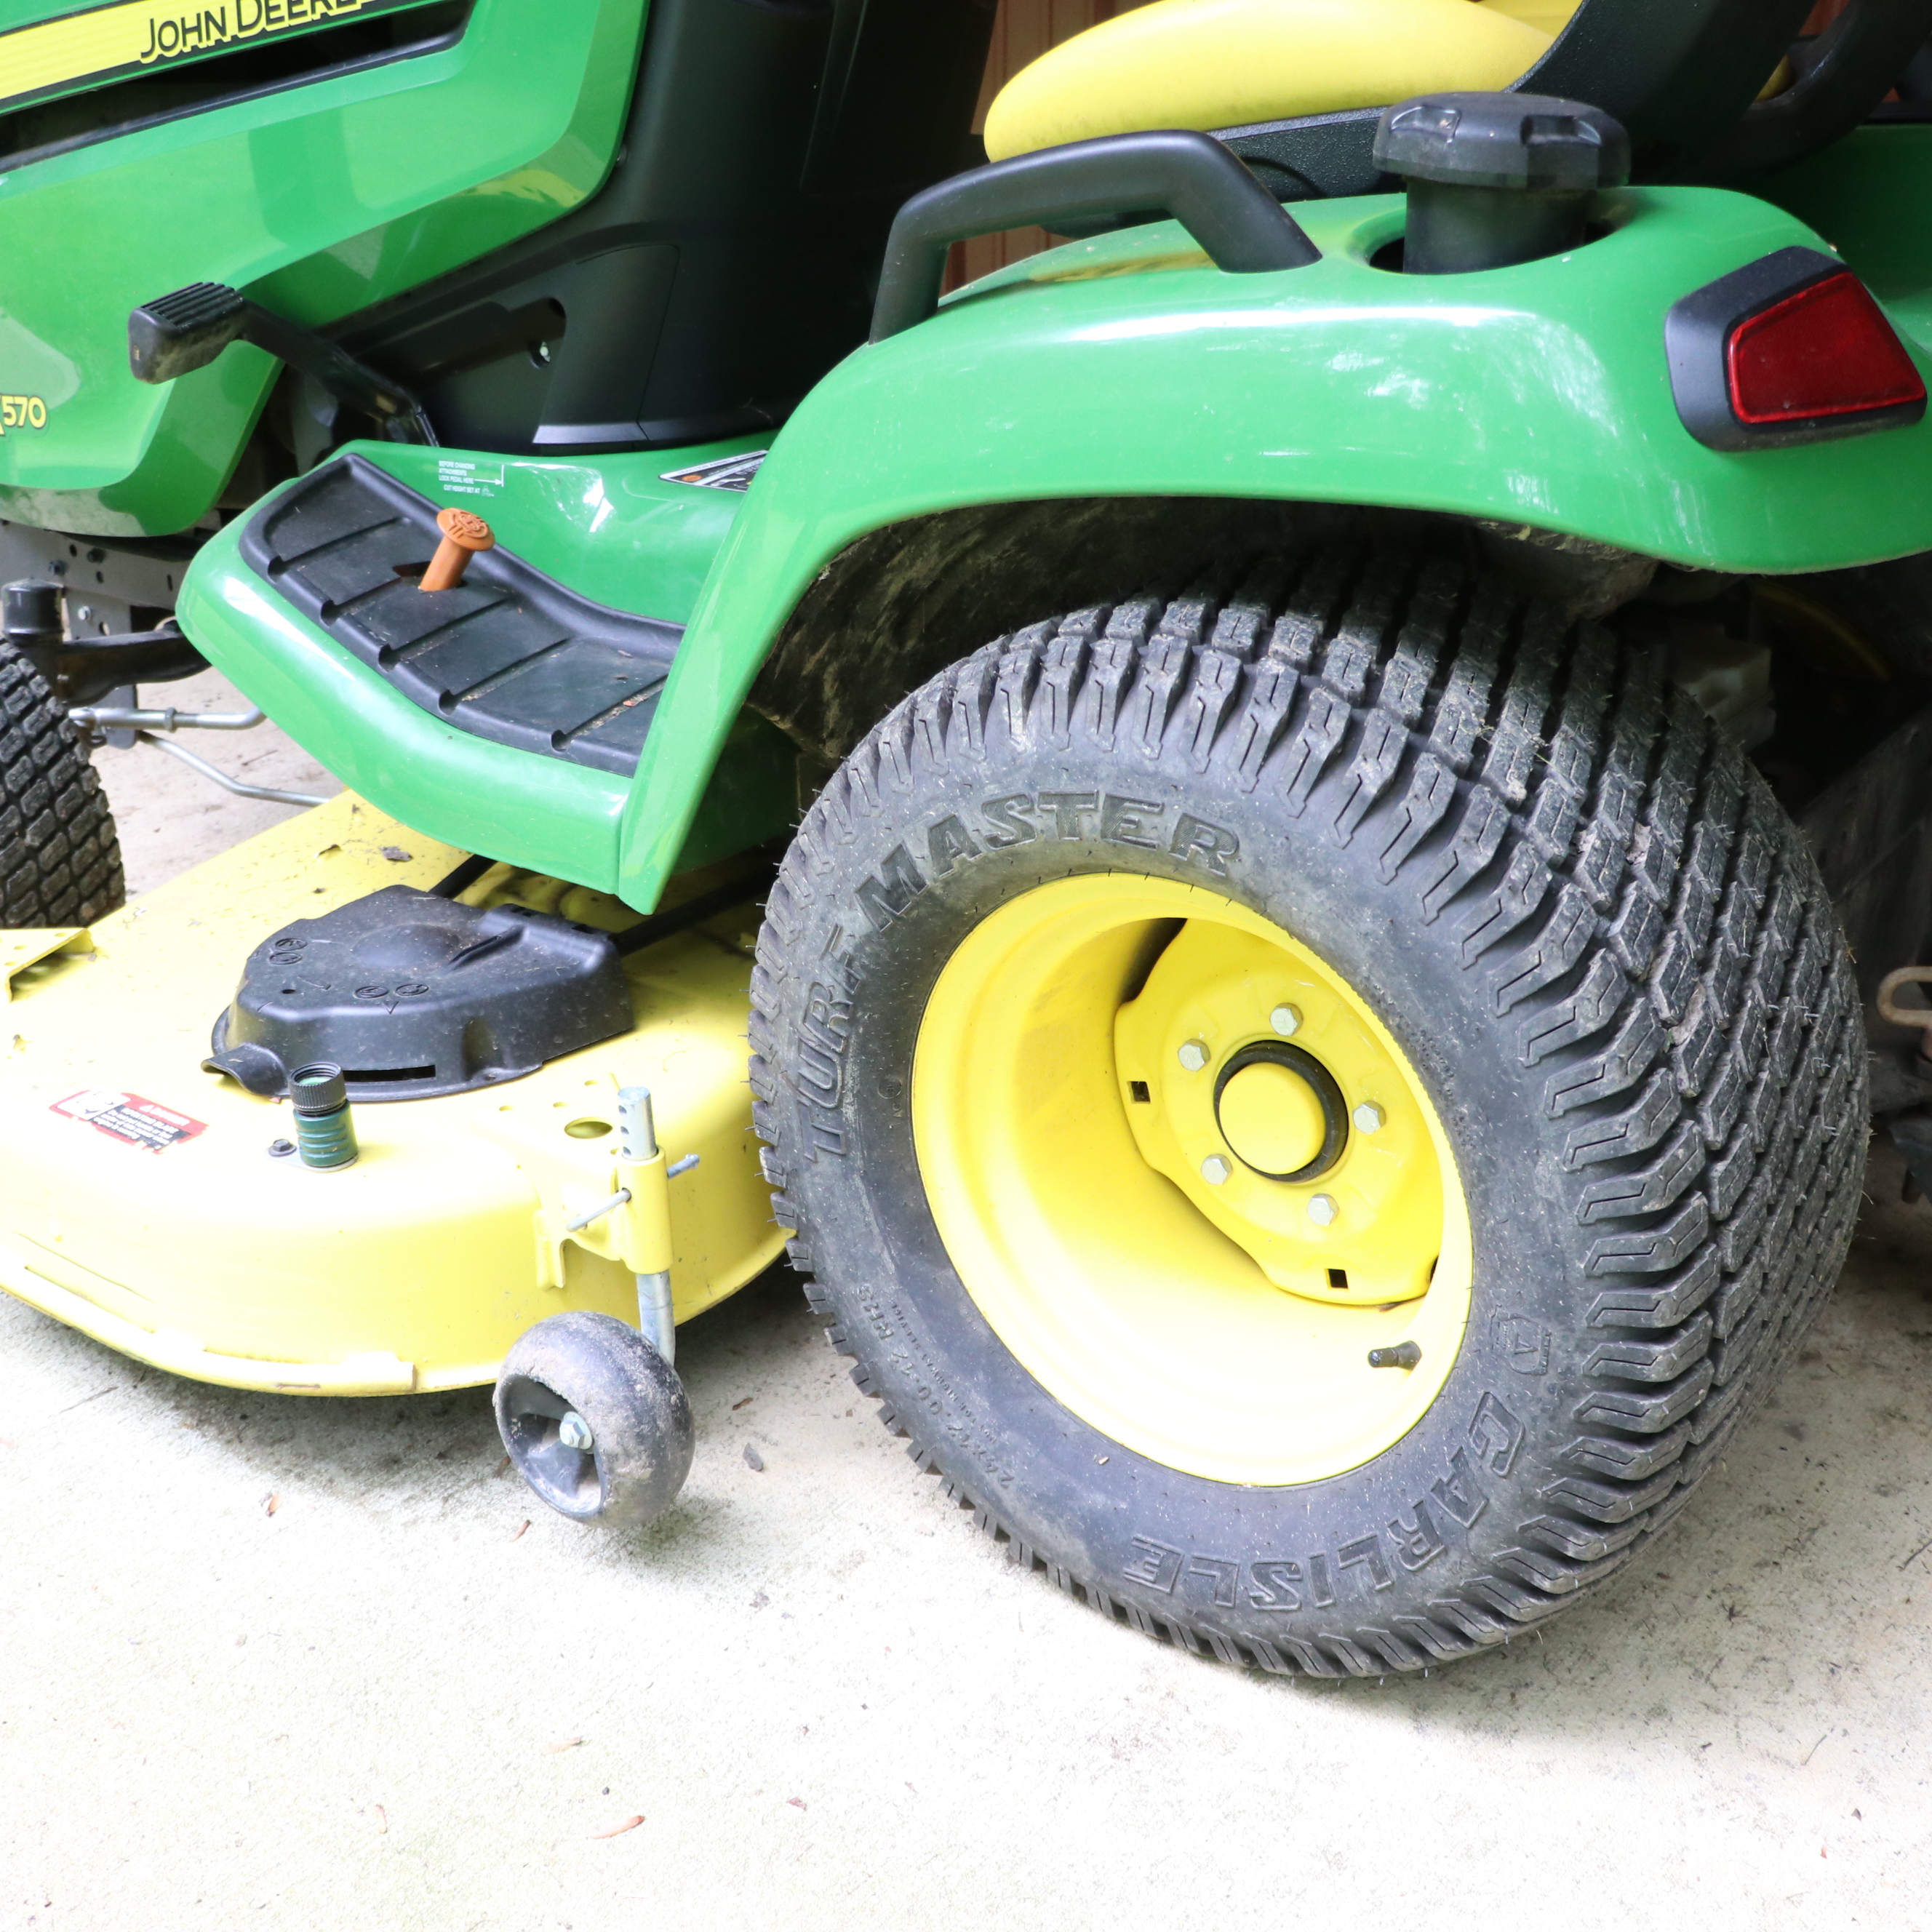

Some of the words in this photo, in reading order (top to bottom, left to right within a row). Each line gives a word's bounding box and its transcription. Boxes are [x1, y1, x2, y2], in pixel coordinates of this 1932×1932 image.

[140, 7, 228, 59] JOHN
[797, 925, 865, 1162] TURF
[855, 791, 1241, 932] MASTER
[148, 1107, 191, 1126] DANGER
[919, 1351, 959, 1403] HIGHWAY
[1123, 1390, 1527, 1612] CARLISLE
